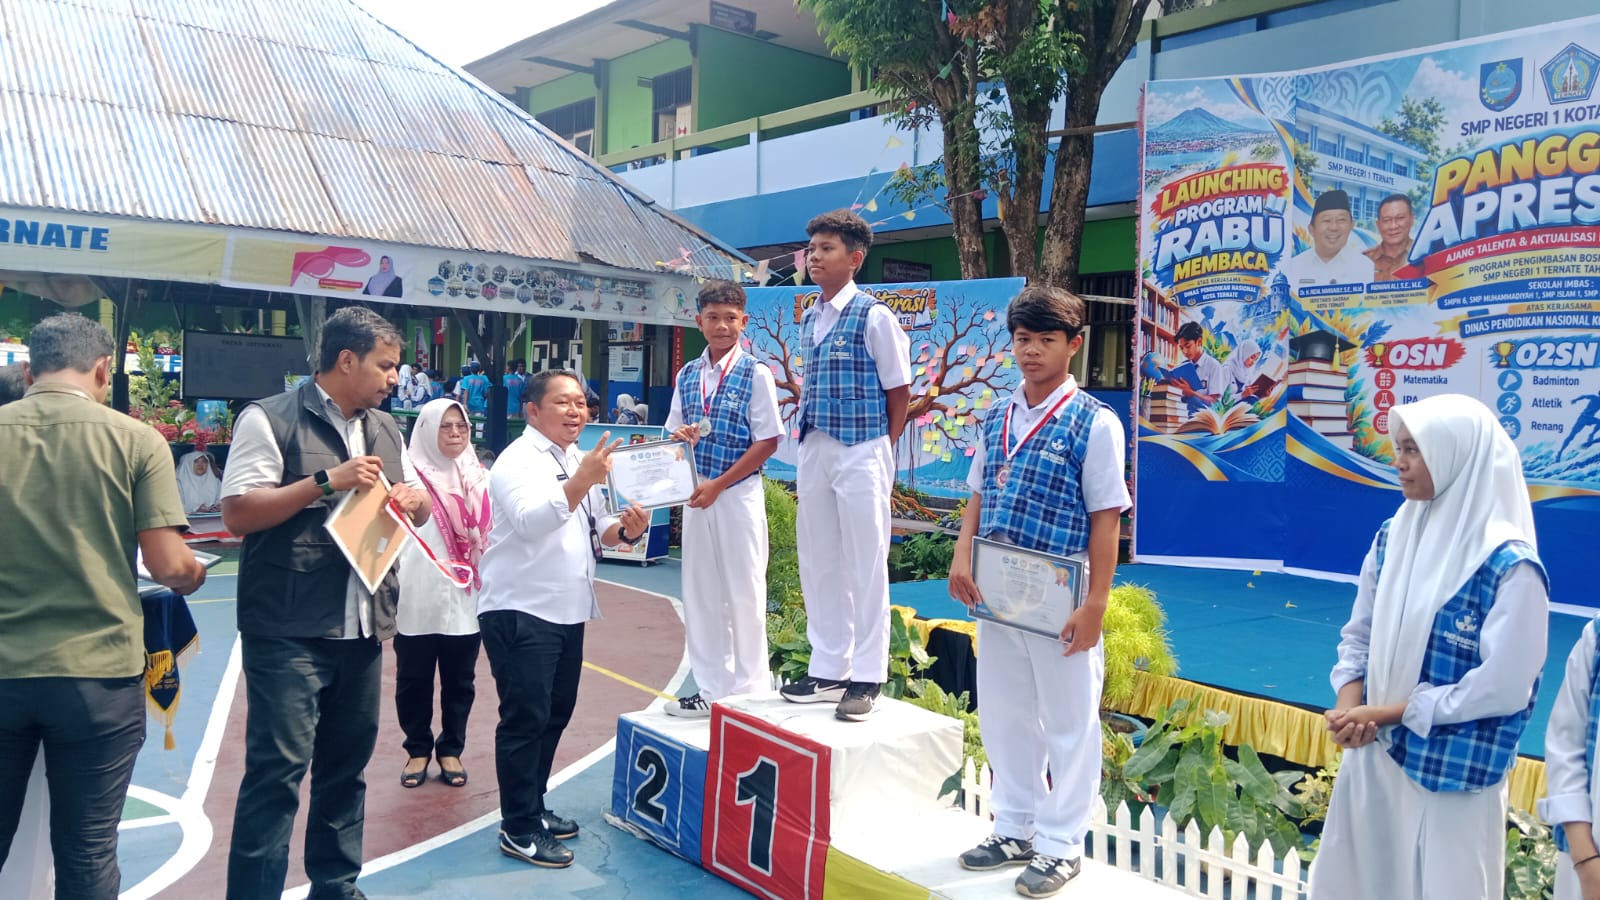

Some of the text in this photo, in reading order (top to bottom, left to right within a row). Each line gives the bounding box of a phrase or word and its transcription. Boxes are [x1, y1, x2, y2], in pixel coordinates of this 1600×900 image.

[1460, 119, 1491, 137] SMP
[1494, 111, 1548, 132] NEGERI
[1553, 110, 1559, 125] 1
[1327, 161, 1395, 186] SMP NEGERI 1 TERNATE
[1160, 168, 1283, 214] LAUNCHING
[1174, 195, 1263, 228] PROGRAM
[1156, 216, 1284, 272] RABU
[1446, 246, 1474, 264] AJANG
[1477, 238, 1517, 254] TALENTA
[1519, 236, 1528, 246] &
[1530, 232, 1596, 246] AKTUALISASI
[1173, 251, 1270, 283] MEMBACA
[1468, 253, 1600, 274] PROGRAM PENGIMBASAN BOS
[1482, 271, 1501, 281] SMP
[1503, 267, 1534, 279] NEGERI
[1536, 267, 1540, 276] 1
[1543, 264, 1582, 274] TERNATE
[1483, 292, 1534, 302] MUHAMMADIYAH
[1584, 289, 1599, 297] SMP
[1528, 281, 1563, 290] SEKOLAH
[1564, 280, 1590, 288] IMBAS
[1547, 302, 1592, 311] KERJASAMA
[1465, 321, 1489, 335] DINAS
[1491, 316, 1544, 330] PENDIDIKAN
[1545, 314, 1590, 327] NASIONAL
[1388, 342, 1448, 367] OSN
[1515, 341, 1599, 368] O2SN
[1403, 375, 1448, 385] Matematika
[1532, 375, 1580, 386] Badminton
[1403, 395, 1418, 405] IPA
[1532, 398, 1563, 409] Atletik
[1531, 421, 1564, 434] Renang
[631, 745, 670, 827] 2
[735, 755, 780, 878] 1
